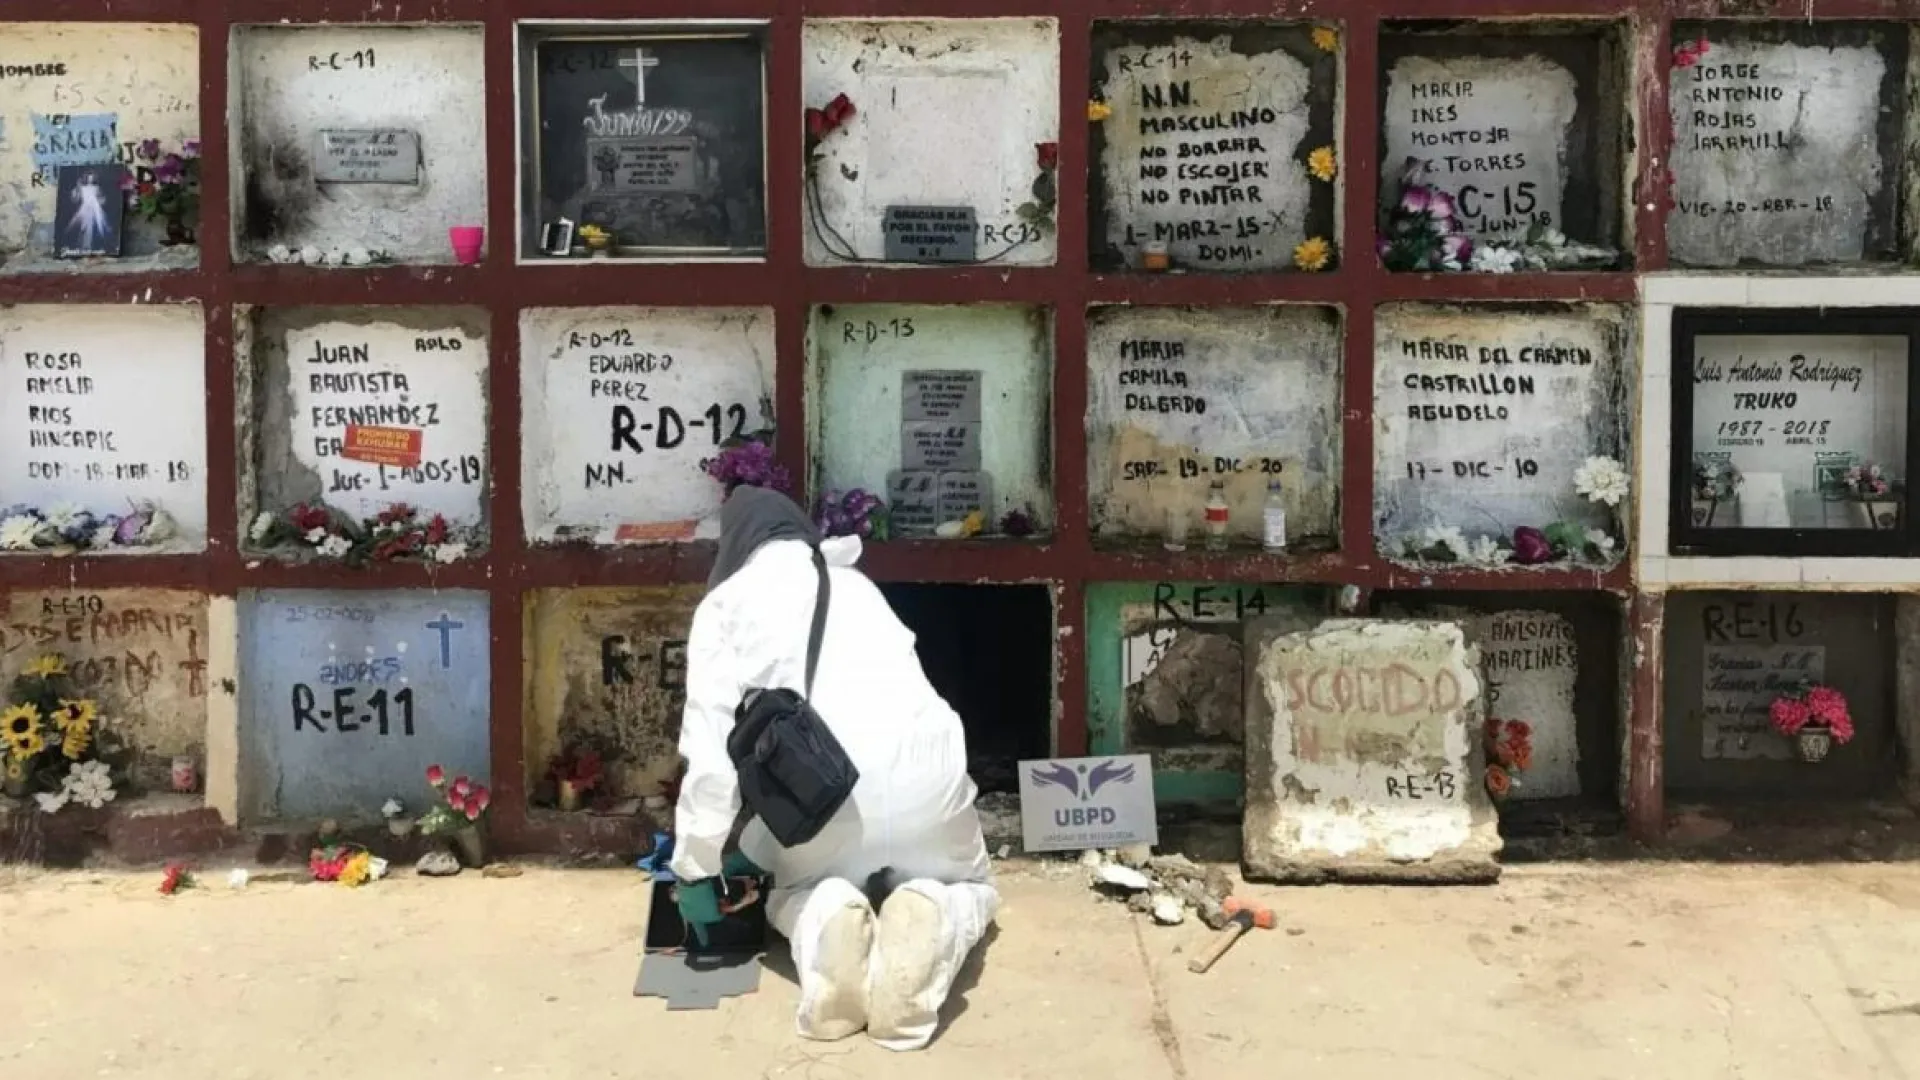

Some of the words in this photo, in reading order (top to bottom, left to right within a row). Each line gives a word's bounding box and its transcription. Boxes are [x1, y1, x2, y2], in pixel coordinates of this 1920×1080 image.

[308, 48, 376, 71] R-C-11
[1119, 50, 1192, 72] R-C-14
[1693, 63, 1760, 82] JORGE
[1140, 107, 1275, 135] MASCULINO
[1412, 104, 1458, 124] INES
[1694, 110, 1756, 129] ROJAS
[1411, 126, 1510, 146] MONTOYA
[1140, 146, 1167, 160] NO
[1177, 137, 1266, 159] BORRAR
[1140, 166, 1168, 180] NO
[1443, 153, 1526, 173] TORRES
[1141, 190, 1170, 205] NO
[1179, 185, 1263, 206] PINTAR
[569, 329, 634, 348] R-D-12
[843, 318, 914, 343] R-D-13
[308, 340, 368, 364] JUAN
[1120, 340, 1185, 360] MARIA
[1402, 342, 1469, 361] MARIA
[1479, 346, 1512, 365] DEL
[1519, 347, 1592, 365] CARMEN
[25, 353, 82, 370] ROSA
[589, 353, 673, 373] EDUARDO
[310, 372, 409, 393] BAUTISTA
[1119, 369, 1188, 388] CAMILA
[1727, 355, 1783, 383] Antonio
[1789, 355, 1863, 391] Rodriguez
[27, 376, 93, 394] AMELIA
[591, 379, 649, 401] PEREZ
[1404, 373, 1535, 395] CASTRILLON
[1125, 393, 1206, 414] DELGADO
[1733, 392, 1797, 410] TRUKO
[29, 406, 72, 424] RIOS
[1408, 405, 1508, 421] AGUDELO
[612, 402, 747, 453] R-D-12
[1718, 421, 1762, 435] 1987
[1783, 421, 1831, 435] 2018
[43, 595, 103, 615] R-E-10
[292, 684, 415, 736] R-E-11
[1386, 773, 1455, 800] R-E-13
[1054, 807, 1116, 827] UBPD
